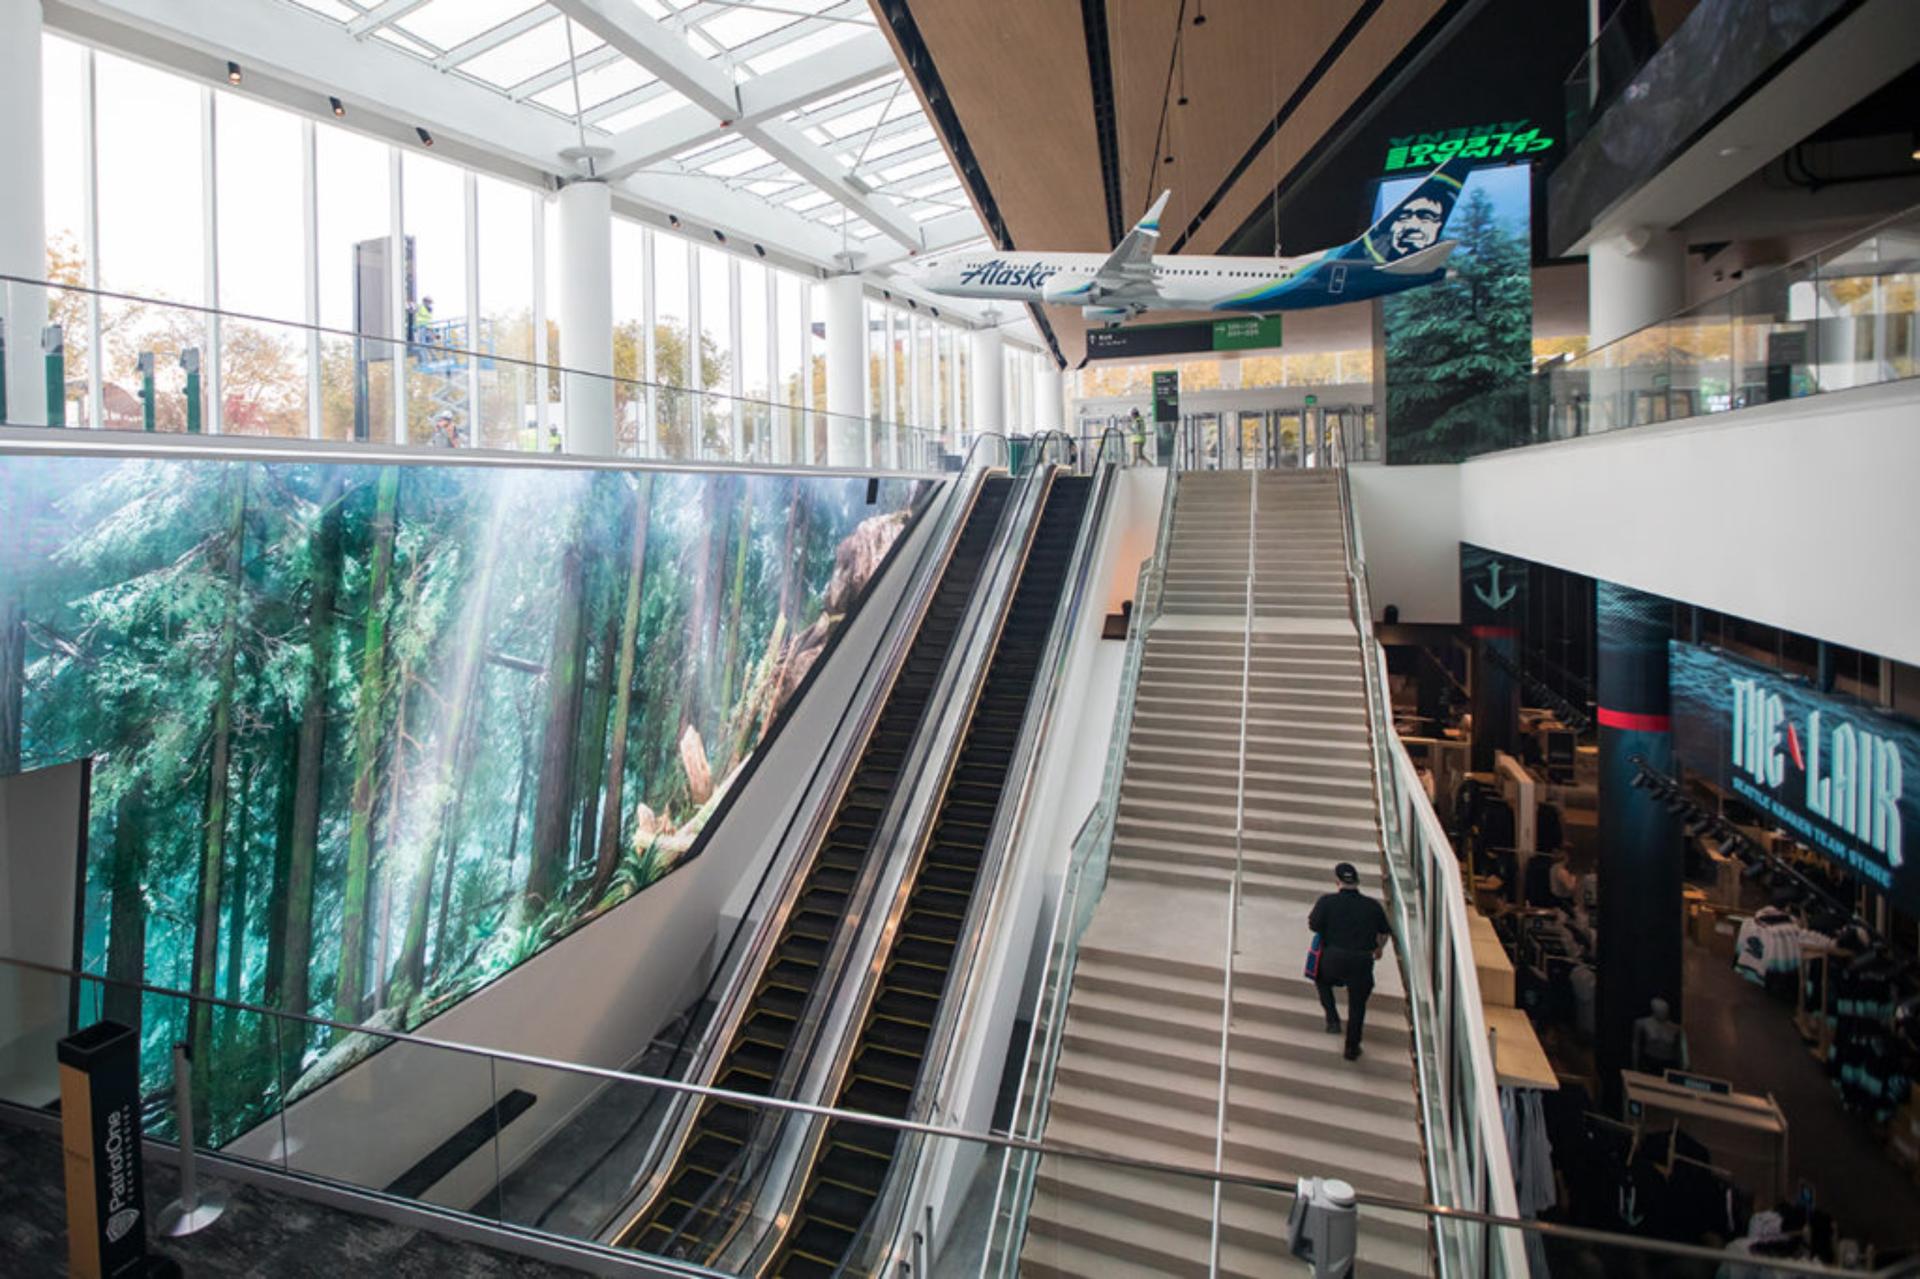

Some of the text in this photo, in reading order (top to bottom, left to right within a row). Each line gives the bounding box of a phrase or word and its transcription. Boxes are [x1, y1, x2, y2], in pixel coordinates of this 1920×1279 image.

[1731, 677, 1903, 867] THE LAIR
[1814, 827, 1847, 859] TEAM
[1848, 849, 1892, 888] STORE
